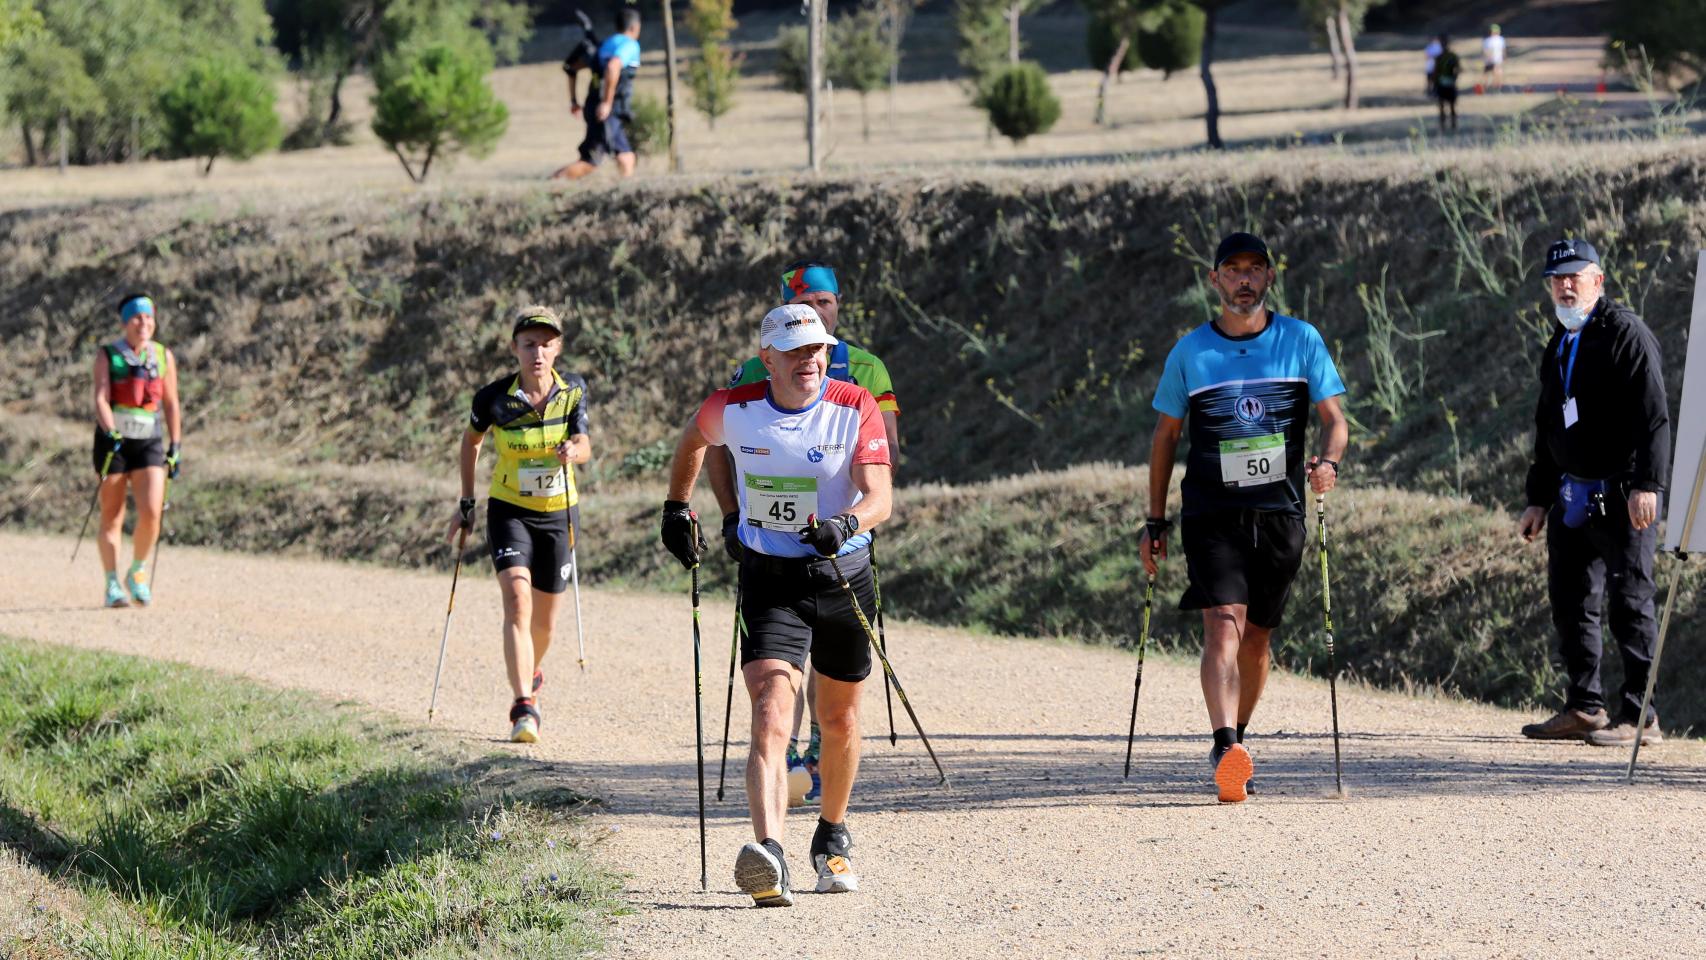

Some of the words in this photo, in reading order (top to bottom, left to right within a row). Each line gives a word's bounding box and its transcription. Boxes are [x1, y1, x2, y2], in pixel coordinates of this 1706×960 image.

[1553, 251, 1557, 260] I
[508, 441, 528, 450] Virto
[817, 443, 845, 451] TIERRA
[1247, 457, 1270, 476] 50
[535, 475, 564, 489] 121
[768, 500, 797, 522] 45
